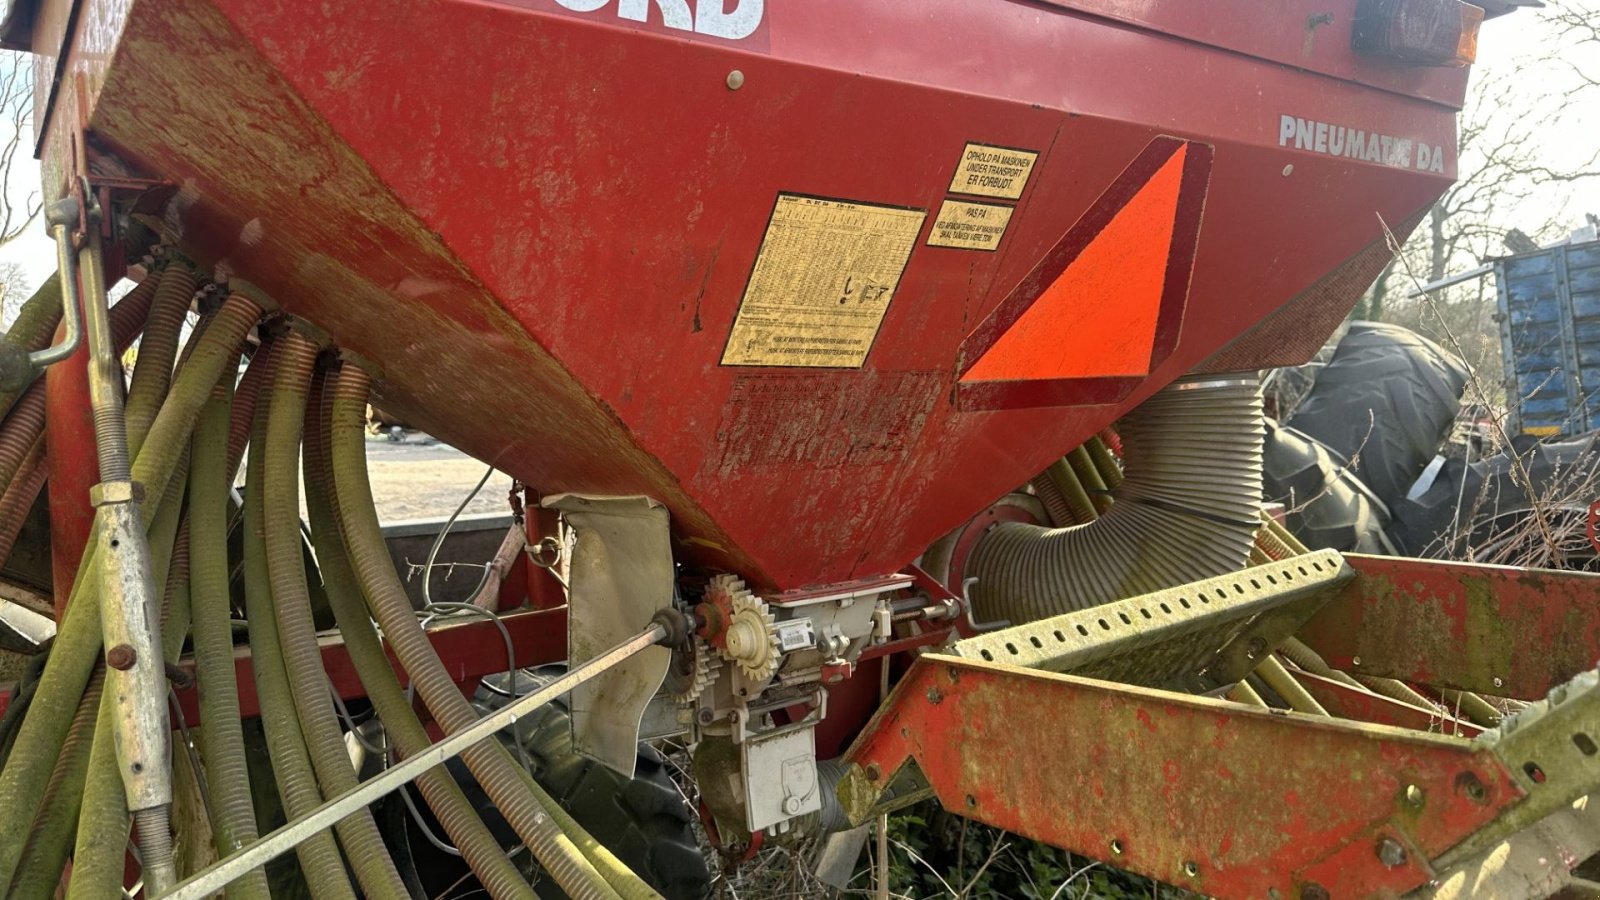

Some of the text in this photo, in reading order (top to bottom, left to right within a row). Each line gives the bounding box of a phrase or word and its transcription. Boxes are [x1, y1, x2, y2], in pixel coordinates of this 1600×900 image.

[967, 151, 992, 162] OPHOLD
[1000, 155, 1031, 168] MASKINEN
[1416, 143, 1444, 174] DA
[966, 163, 1023, 177] UNDER TRANSPORT
[967, 174, 979, 185] ER
[966, 207, 978, 218] PAS
